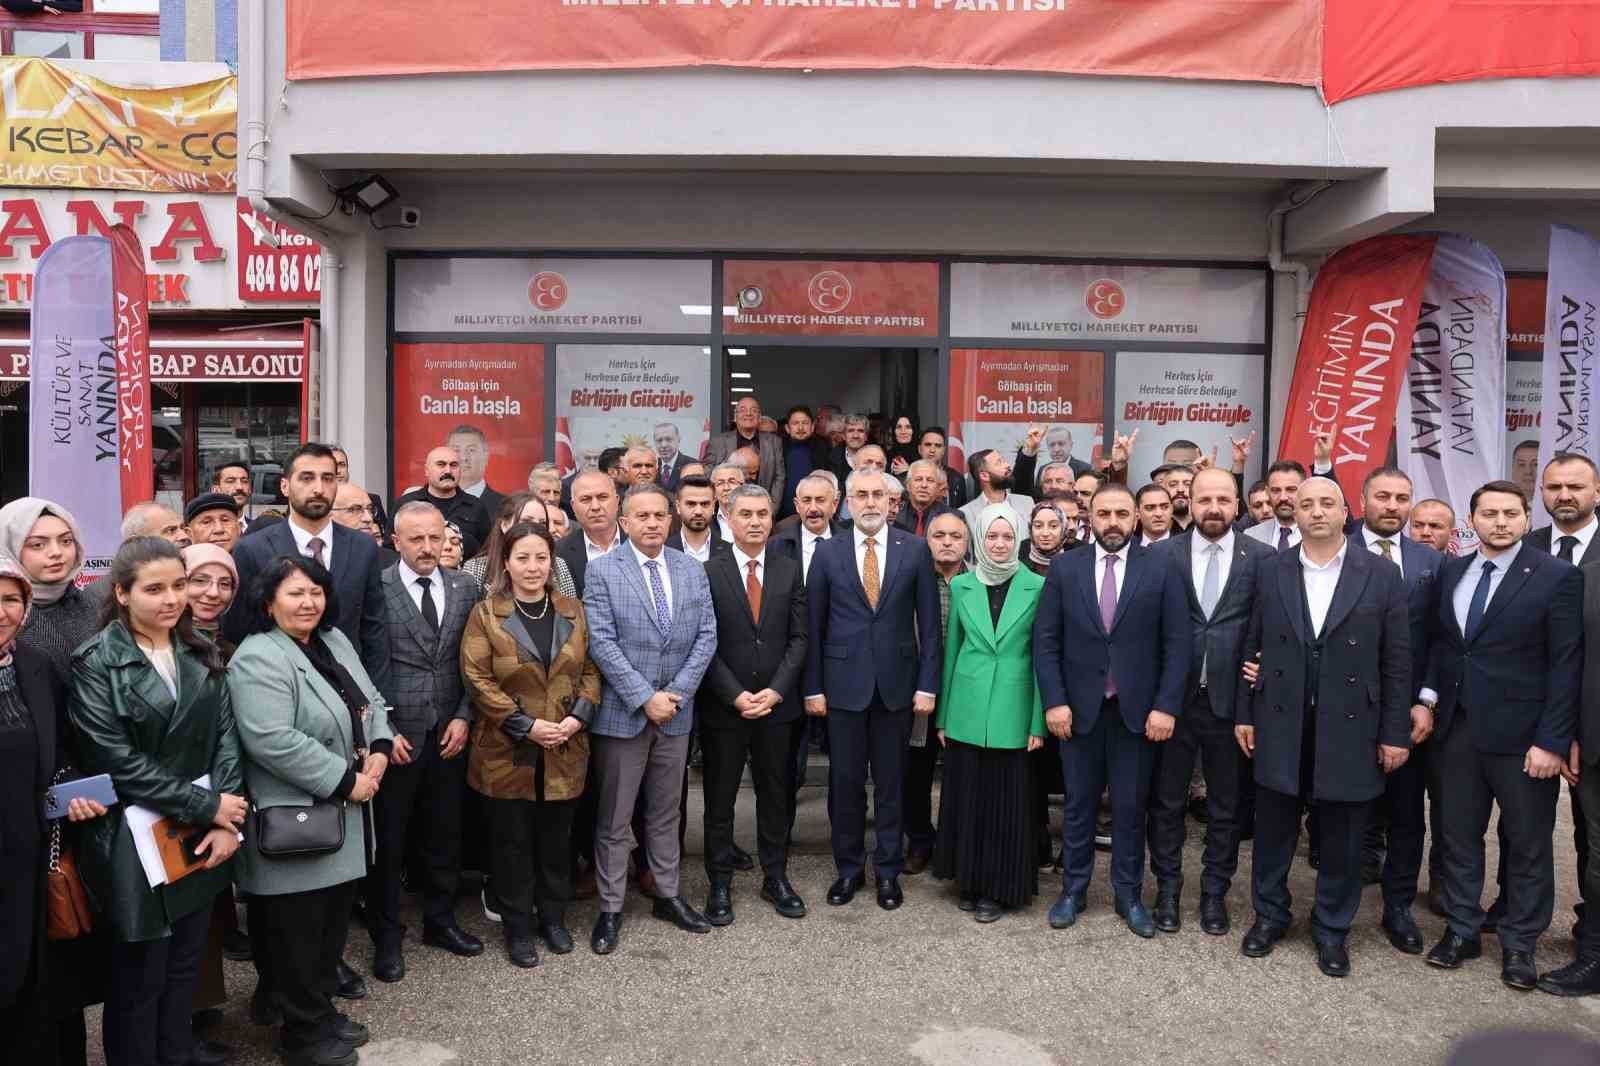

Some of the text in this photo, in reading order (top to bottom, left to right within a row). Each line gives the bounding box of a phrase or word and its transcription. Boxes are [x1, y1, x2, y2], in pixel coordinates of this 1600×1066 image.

[9, 126, 144, 158] KEBAP
[246, 254, 275, 292] 484
[280, 254, 300, 292] 86
[528, 315, 588, 326] HAREKET
[591, 315, 643, 326] PARTİSİ
[734, 314, 925, 327] MİLLİYETÇİ HAREKET PARTİSİ
[1011, 321, 1198, 334] MİLLİYETÇİ HAREKET PARTİSİ
[150, 355, 303, 376] BAP SALONU
[608, 359, 638, 369] Herkes
[1164, 370, 1196, 381] Herkes
[1306, 312, 1358, 436] EĞİTİMİN
[50, 334, 72, 445] KÜLTÜR VE
[441, 378, 478, 393] Gölbaşı
[620, 372, 641, 383] Göre
[642, 372, 680, 385] Belediye
[997, 380, 1033, 394] Gölbaşı
[1336, 298, 1404, 465] YANINDA
[78, 360, 94, 427] SANAT
[96, 336, 117, 462] YANINDA
[570, 387, 694, 412] Birliğin Gücüyle
[1177, 385, 1198, 396] Göre
[1199, 385, 1238, 398] Belediye
[420, 394, 521, 419] Canla başla
[976, 394, 1073, 418] Canla başla
[1124, 400, 1252, 427] Birliğin Gücüyle
